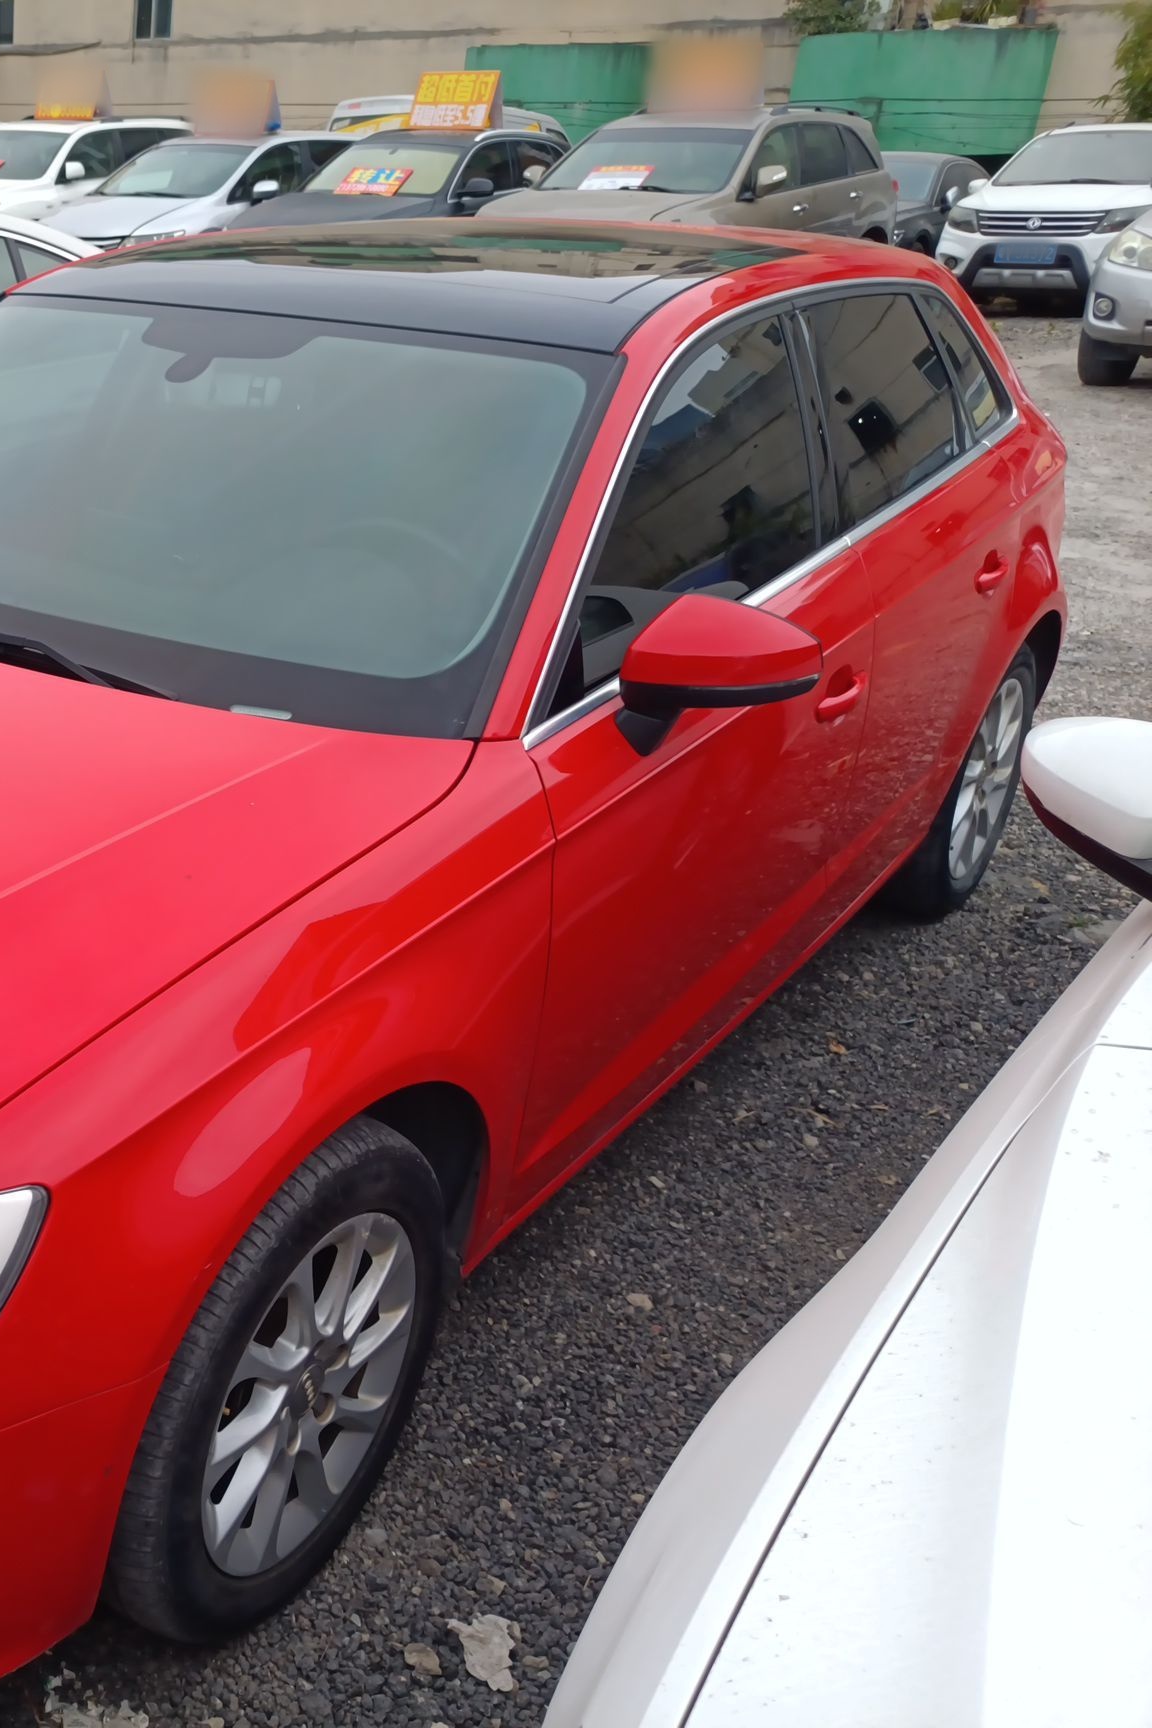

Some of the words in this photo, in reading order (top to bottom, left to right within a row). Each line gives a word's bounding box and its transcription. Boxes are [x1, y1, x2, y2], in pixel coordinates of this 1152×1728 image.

[417, 74, 496, 102] 超低首付
[346, 167, 405, 185] 转让
